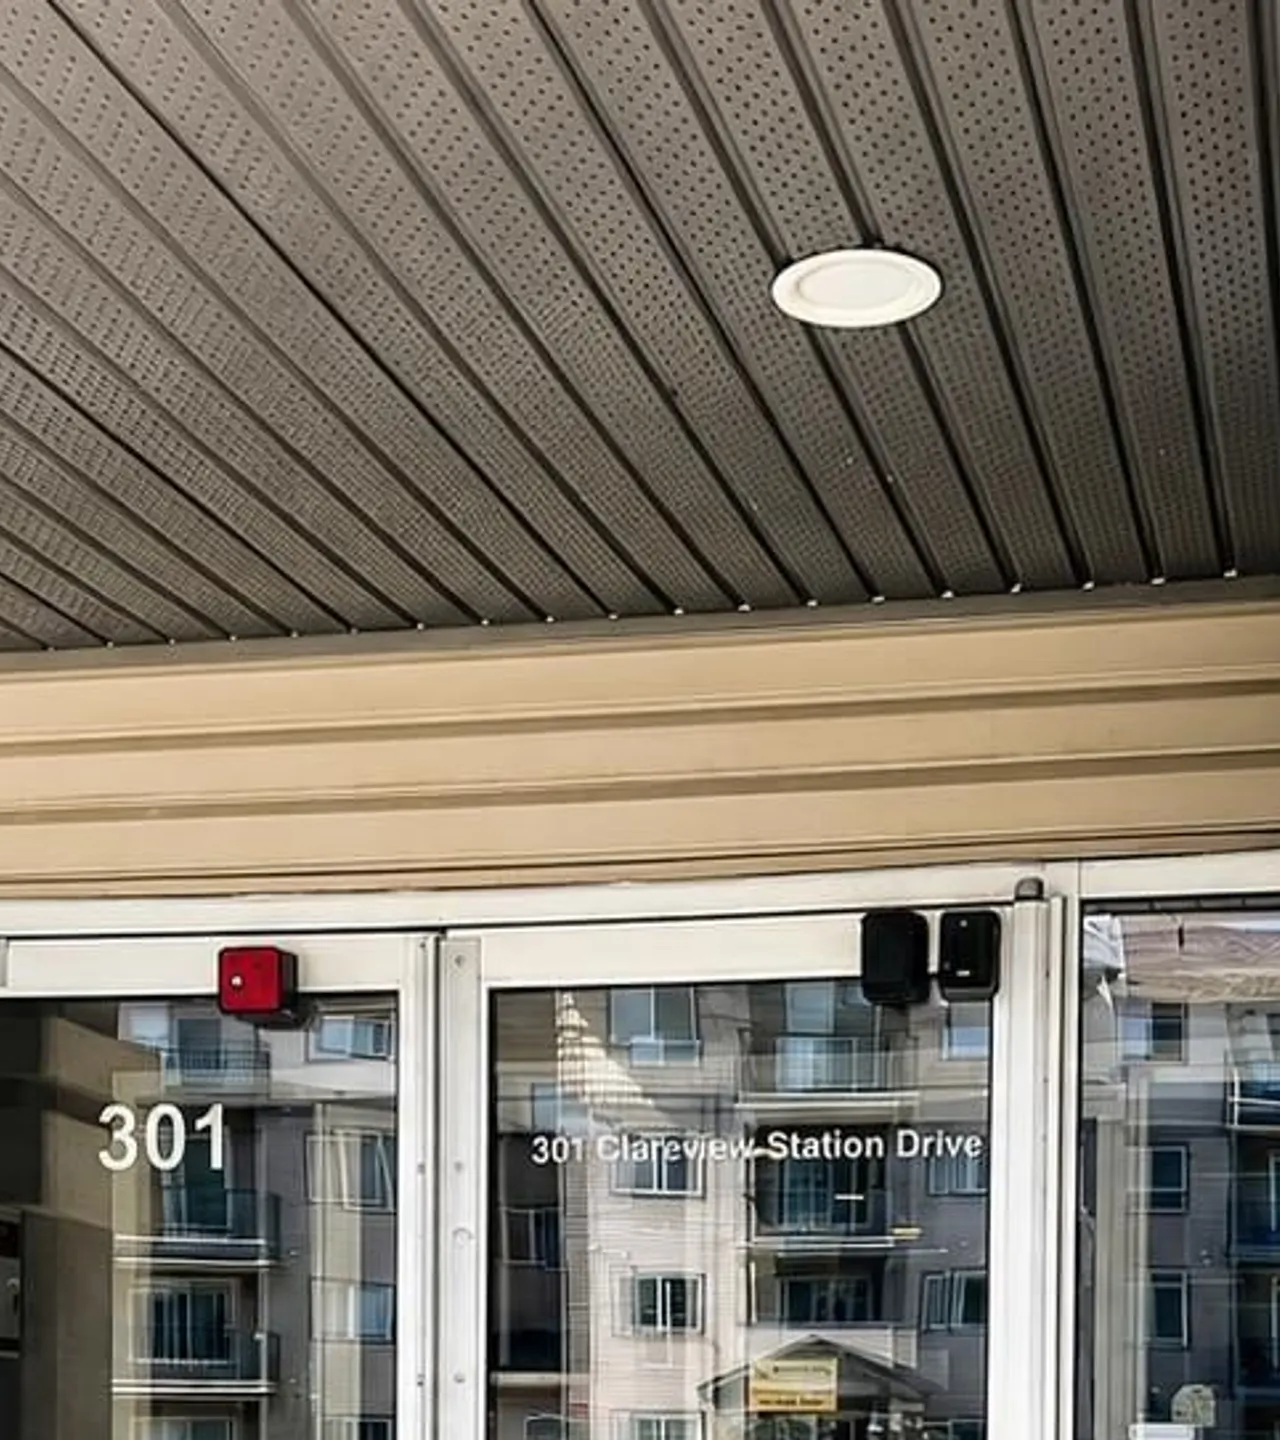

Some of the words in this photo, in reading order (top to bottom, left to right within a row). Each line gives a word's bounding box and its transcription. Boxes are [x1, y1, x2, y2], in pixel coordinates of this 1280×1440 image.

[99, 1103, 223, 1171] 301
[531, 1134, 583, 1164] 301
[597, 1132, 755, 1162] Clareview
[767, 1129, 884, 1161] Station
[896, 1128, 984, 1159] Drive
